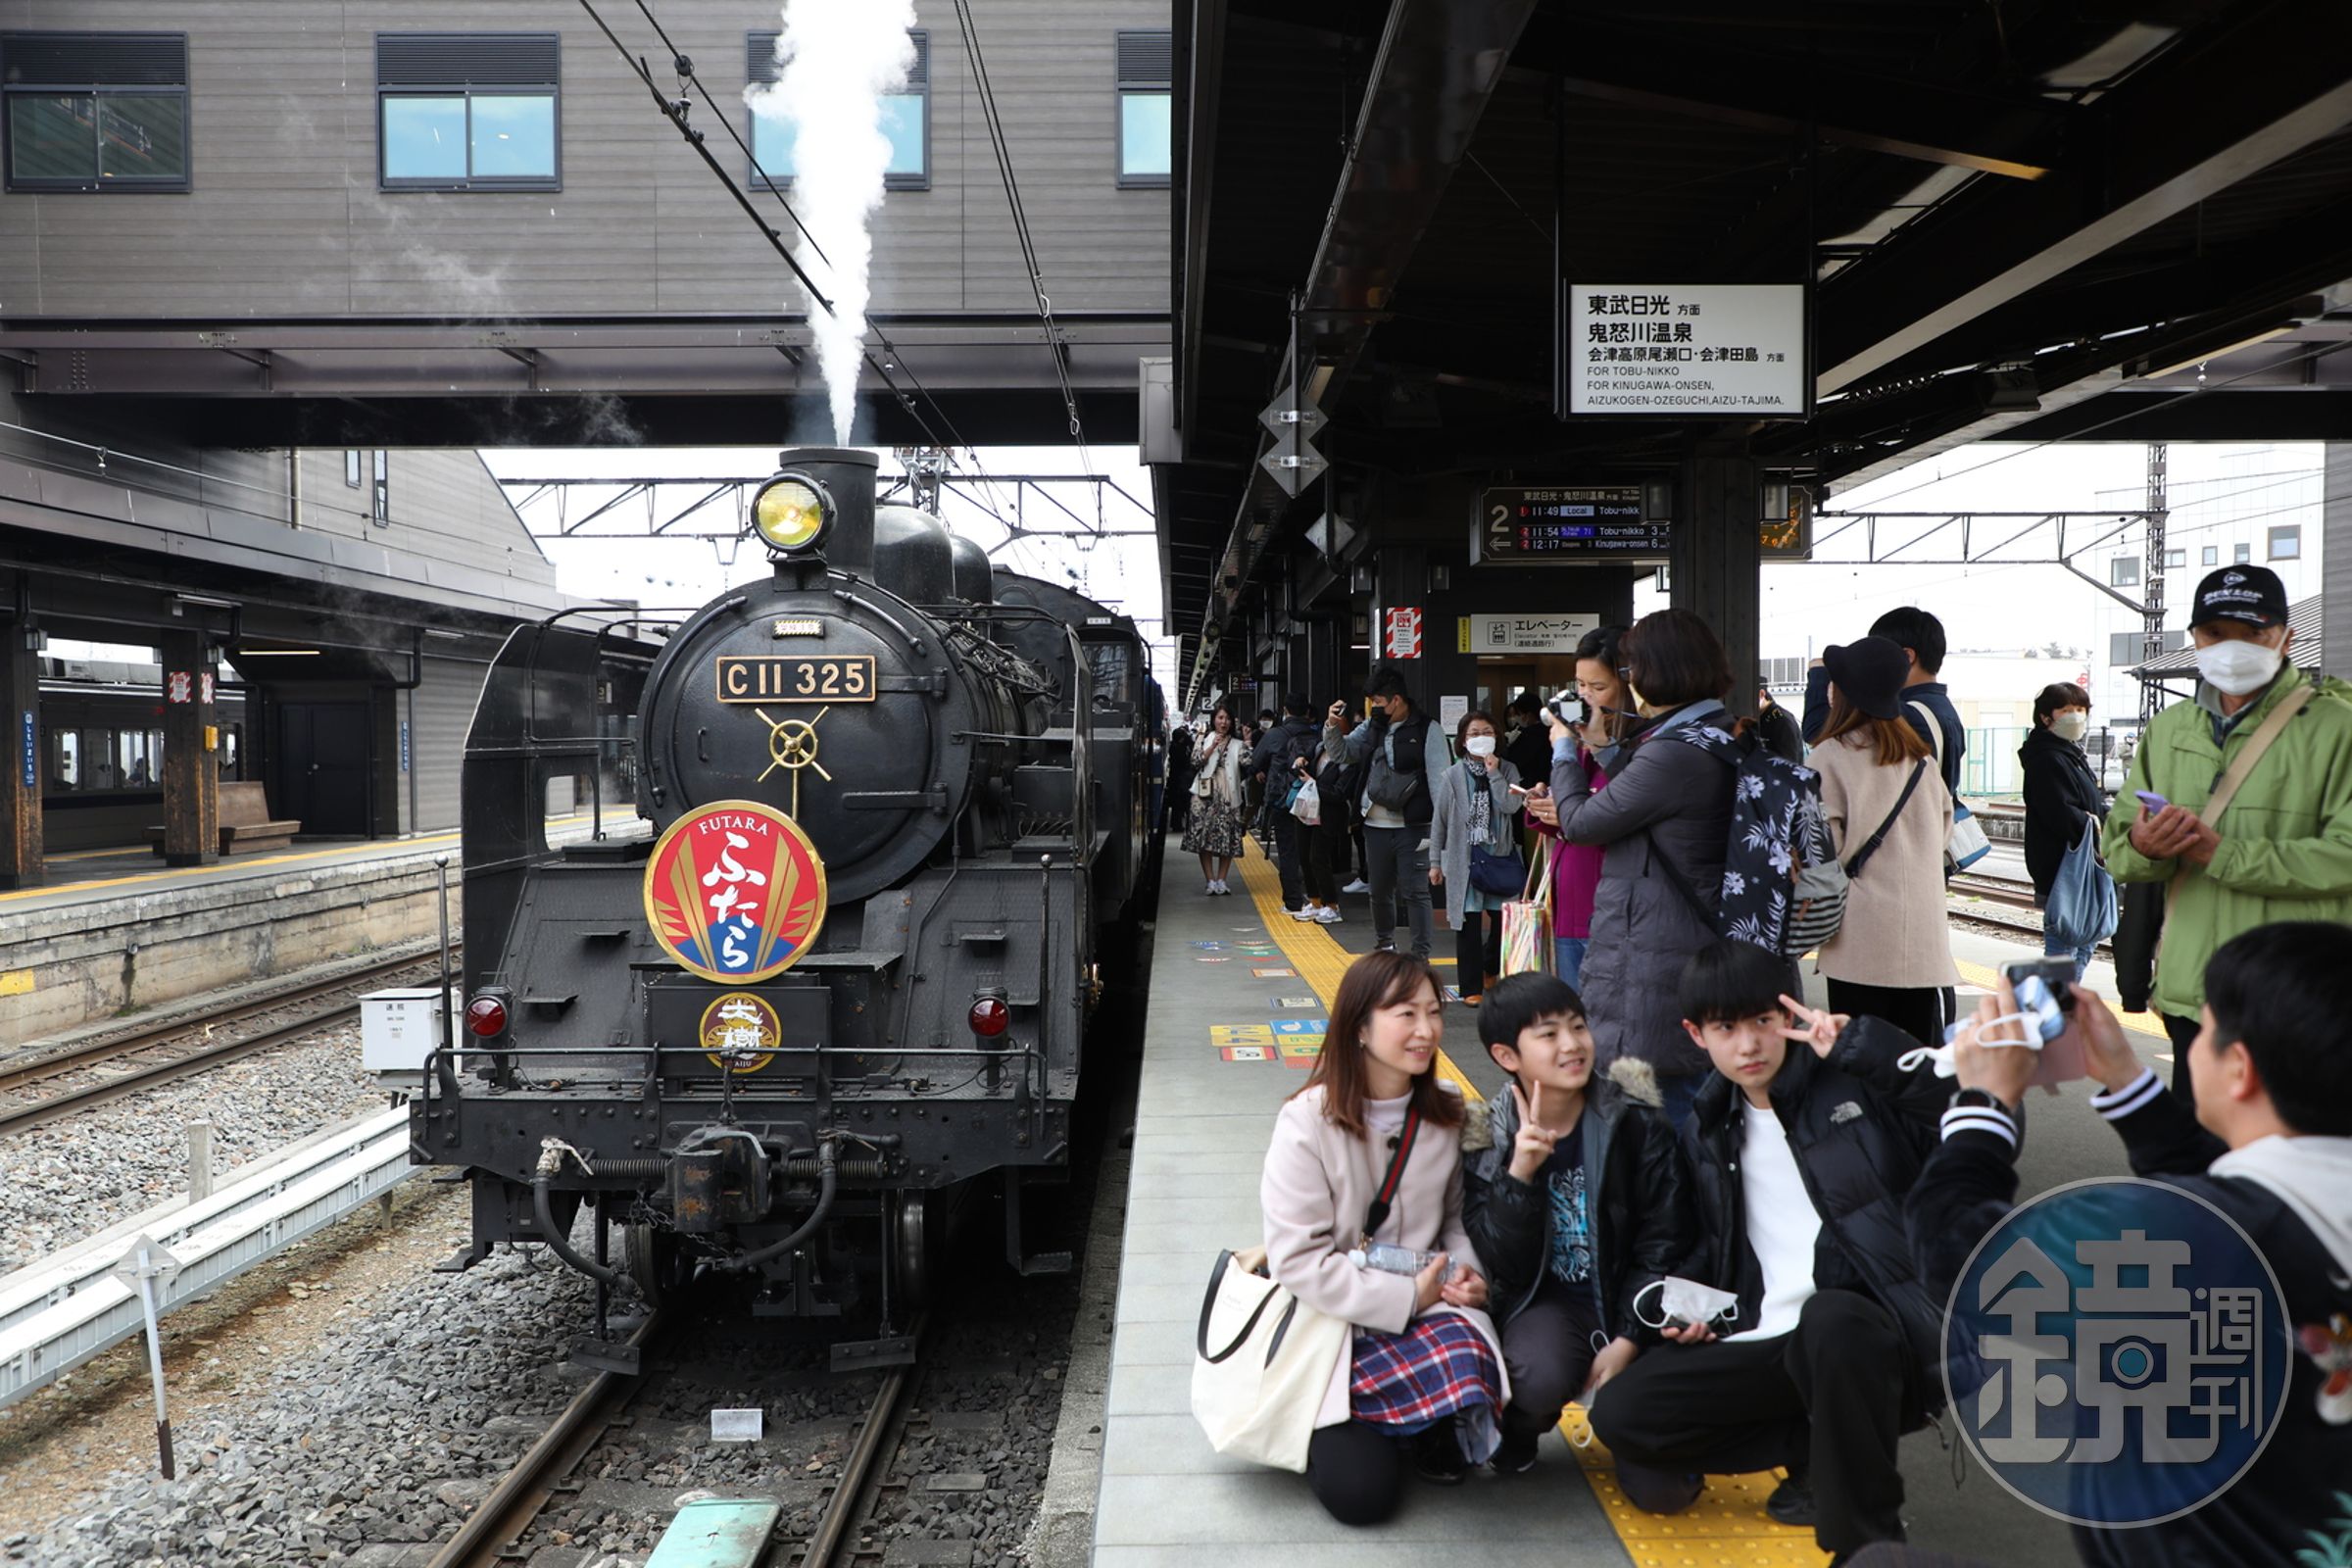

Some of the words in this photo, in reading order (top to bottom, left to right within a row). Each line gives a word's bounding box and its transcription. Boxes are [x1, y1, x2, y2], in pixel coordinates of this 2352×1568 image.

[1588, 295, 1670, 316] 東武日光
[1677, 304, 1700, 316] 方面
[1588, 322, 1692, 343] 鬼怒川温泉
[1767, 353, 1785, 363] 方面
[1587, 366, 1609, 376] FOR
[1612, 366, 1680, 376] TOBU-NIKKO
[1587, 380, 1609, 390] FOR
[1612, 380, 1715, 392] KINUGAWA-ONSEN,
[1532, 507, 1559, 516] 11:49
[1599, 507, 1641, 515] Tobu-nikk
[1491, 505, 1510, 533] 2
[1532, 527, 1559, 536] 11:54
[1599, 527, 1644, 536] Tobu-nikko
[1651, 526, 1658, 535] 3
[1532, 540, 1559, 550] 12:17
[1595, 540, 1649, 550] Kinugawa-onsen
[1651, 539, 1658, 549] 6
[1514, 619, 1583, 631] エレベーター
[796, 662, 865, 695] 325
[1232, 677, 1240, 686] 2
[1203, 698, 1212, 710] 2
[698, 815, 769, 836] FUTARA
[702, 831, 766, 968] ふたら
